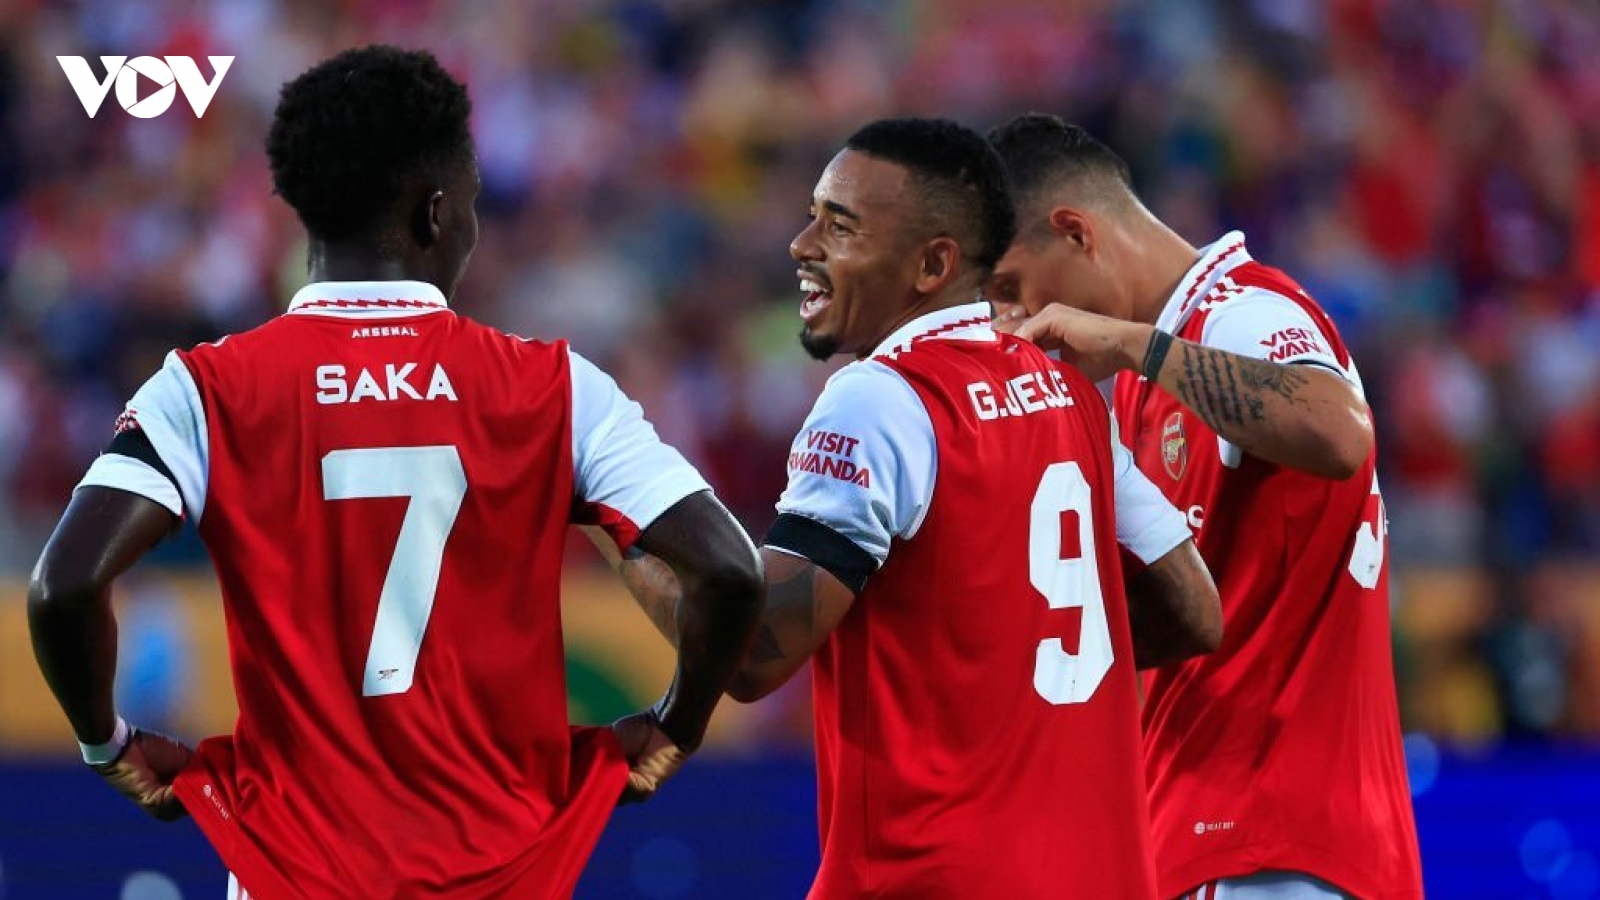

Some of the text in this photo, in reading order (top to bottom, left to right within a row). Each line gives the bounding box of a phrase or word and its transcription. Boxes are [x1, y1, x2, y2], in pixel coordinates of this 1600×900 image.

[351, 326, 419, 339] ARSENAL
[316, 362, 459, 405] SAKA
[807, 429, 860, 457] VISIT
[321, 445, 468, 697] 7
[1029, 461, 1115, 705] 9
